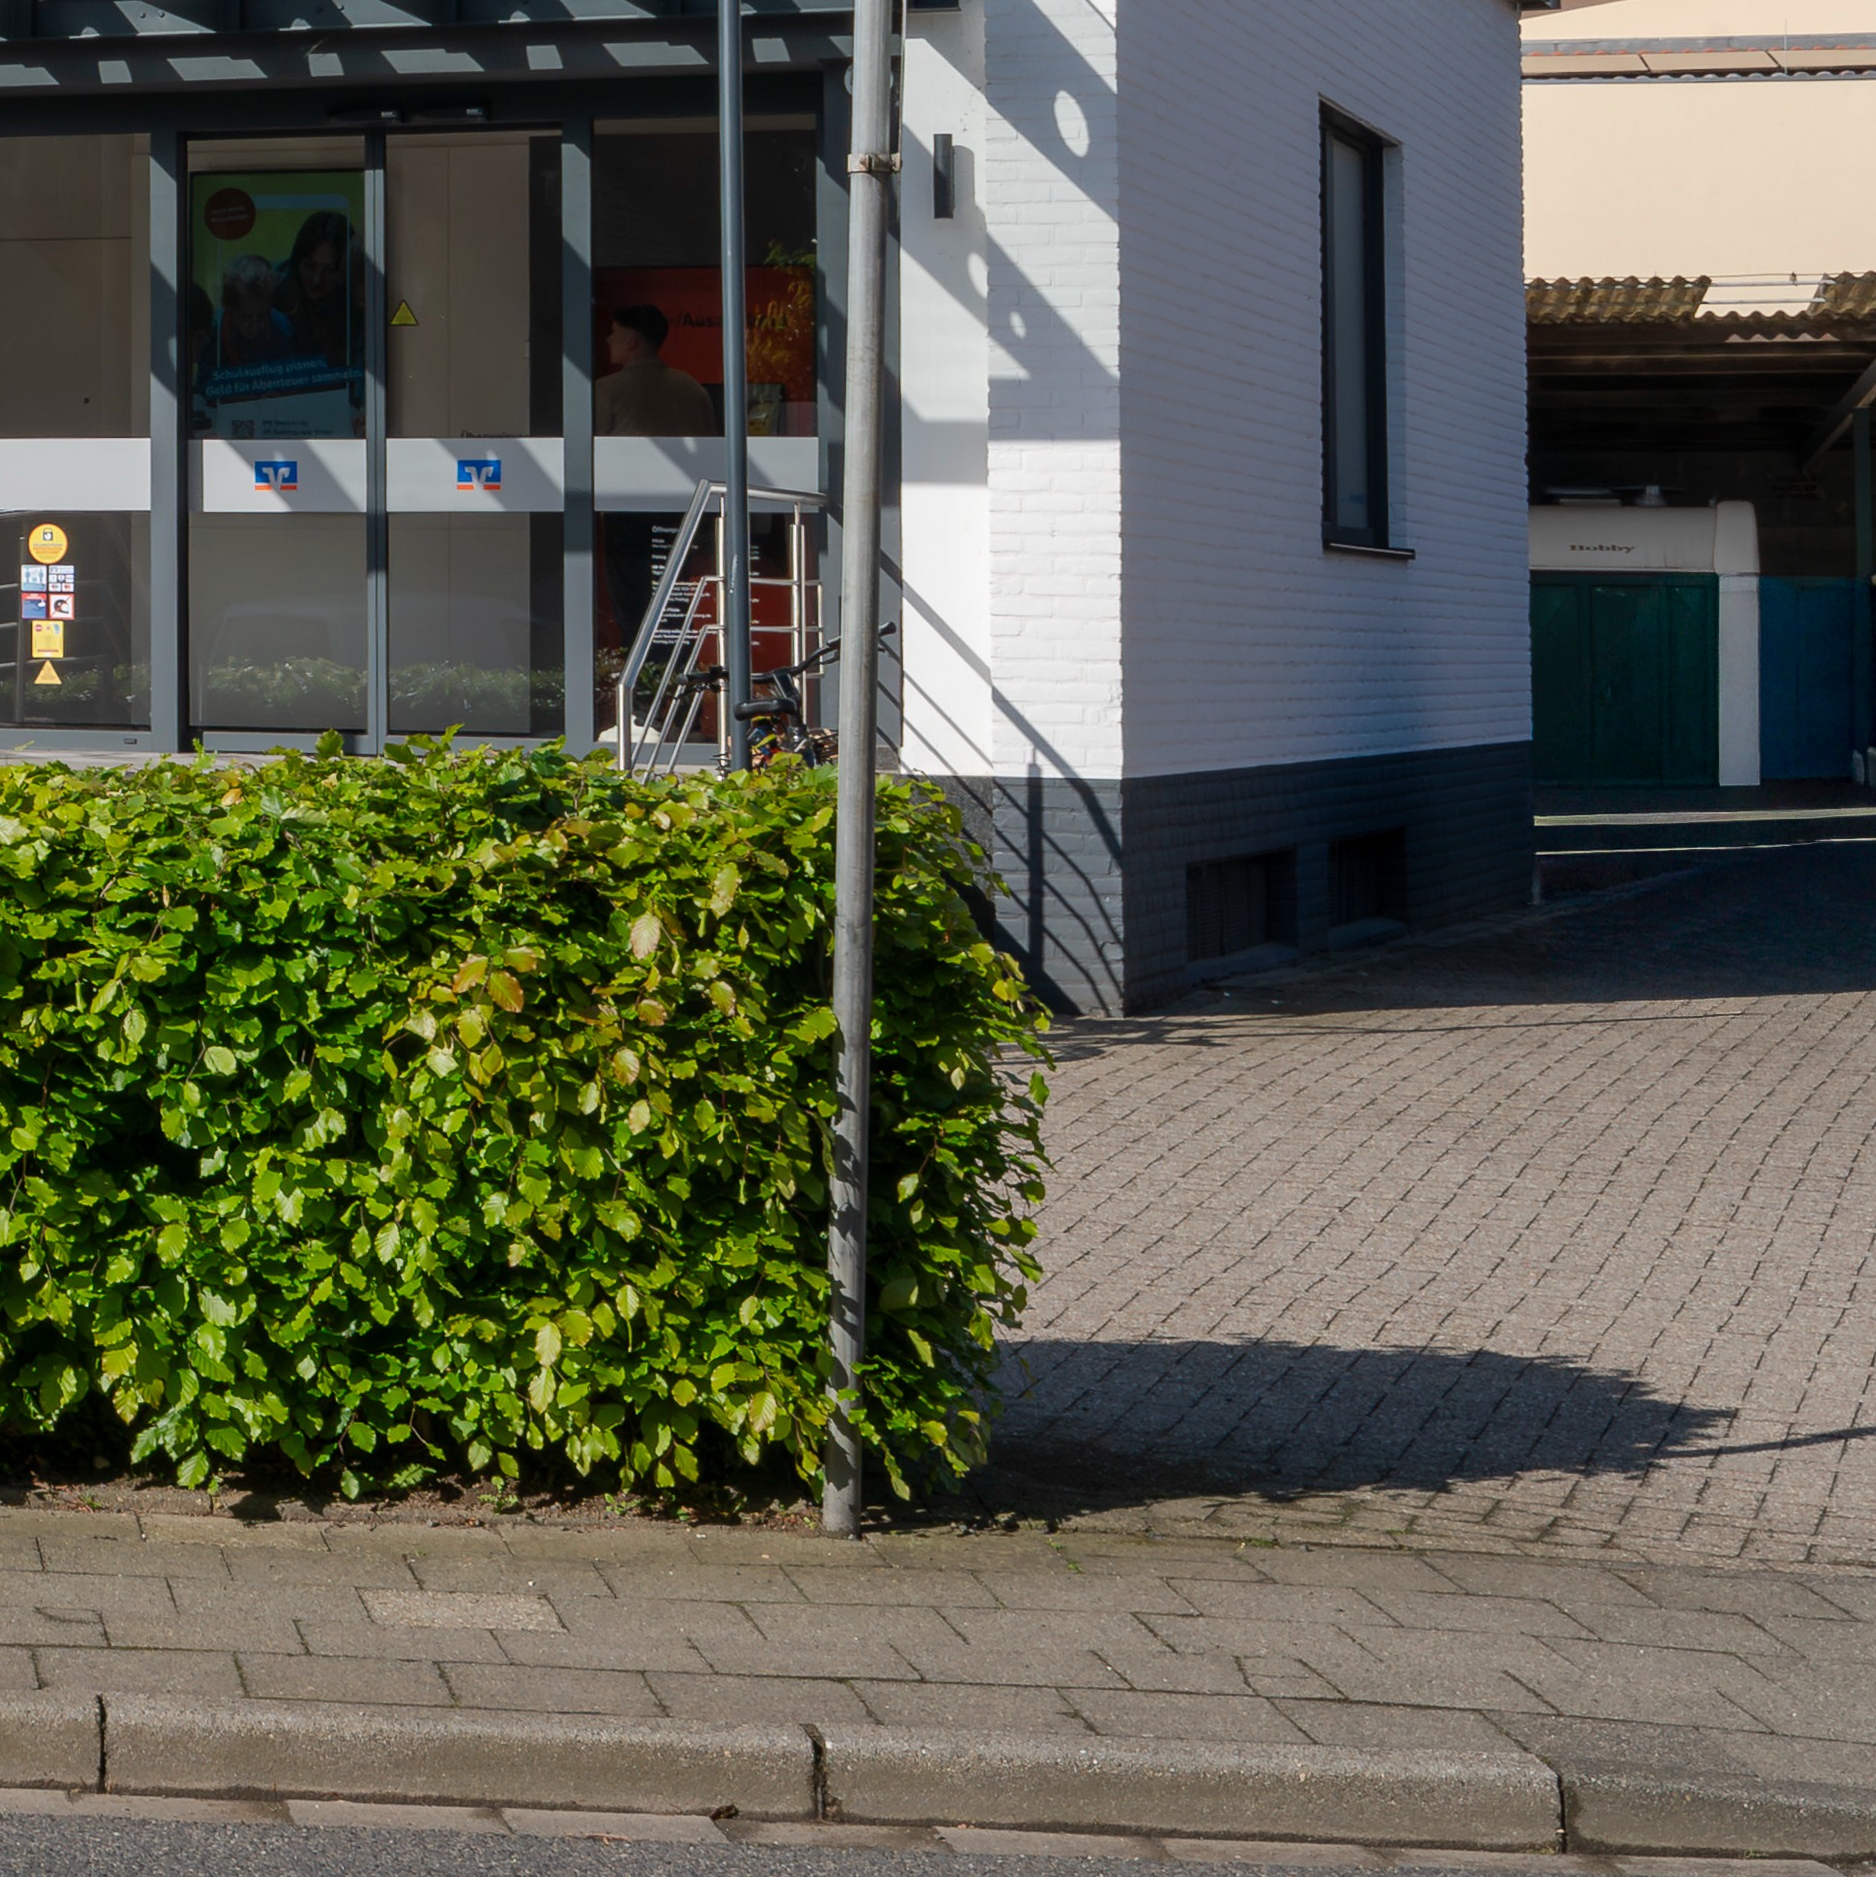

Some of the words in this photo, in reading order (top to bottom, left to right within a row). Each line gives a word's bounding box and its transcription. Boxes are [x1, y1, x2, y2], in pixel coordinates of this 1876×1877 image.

[205, 383, 232, 397] Geld
[233, 381, 250, 394] für
[1570, 544, 1635, 553] Hobby
